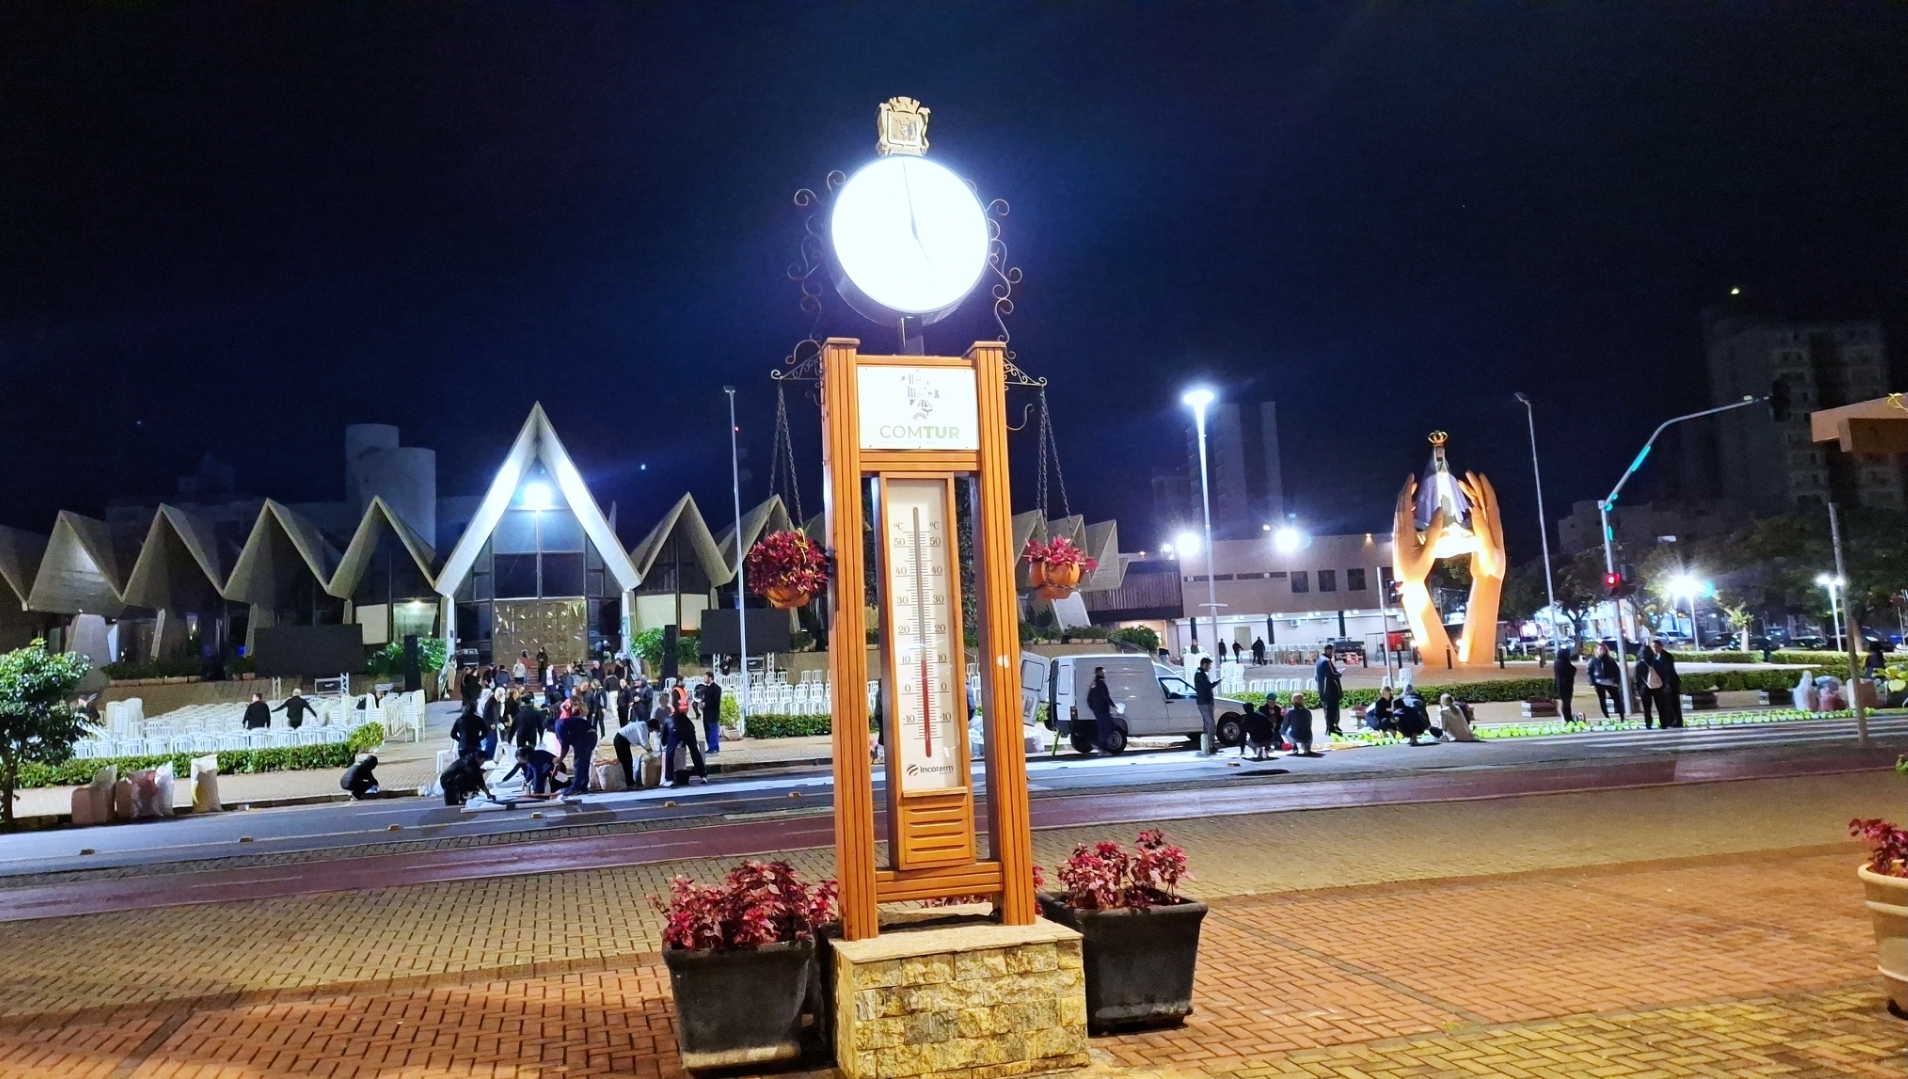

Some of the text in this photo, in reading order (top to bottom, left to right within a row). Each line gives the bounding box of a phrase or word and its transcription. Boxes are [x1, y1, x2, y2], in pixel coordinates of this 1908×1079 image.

[880, 425, 960, 439] COMTUR
[894, 538, 906, 546] 50
[930, 537, 942, 546] 50
[895, 566, 907, 575] 40
[931, 566, 942, 574] 40
[896, 596, 908, 604] 30
[933, 595, 944, 603] 30
[898, 625, 910, 634] 20
[935, 624, 946, 632] 20
[902, 656, 911, 664] 10
[938, 654, 947, 662] 10
[904, 684, 912, 692] 0
[940, 682, 948, 692] 0
[940, 712, 952, 720] -10
[920, 764, 954, 772] Incoterm
